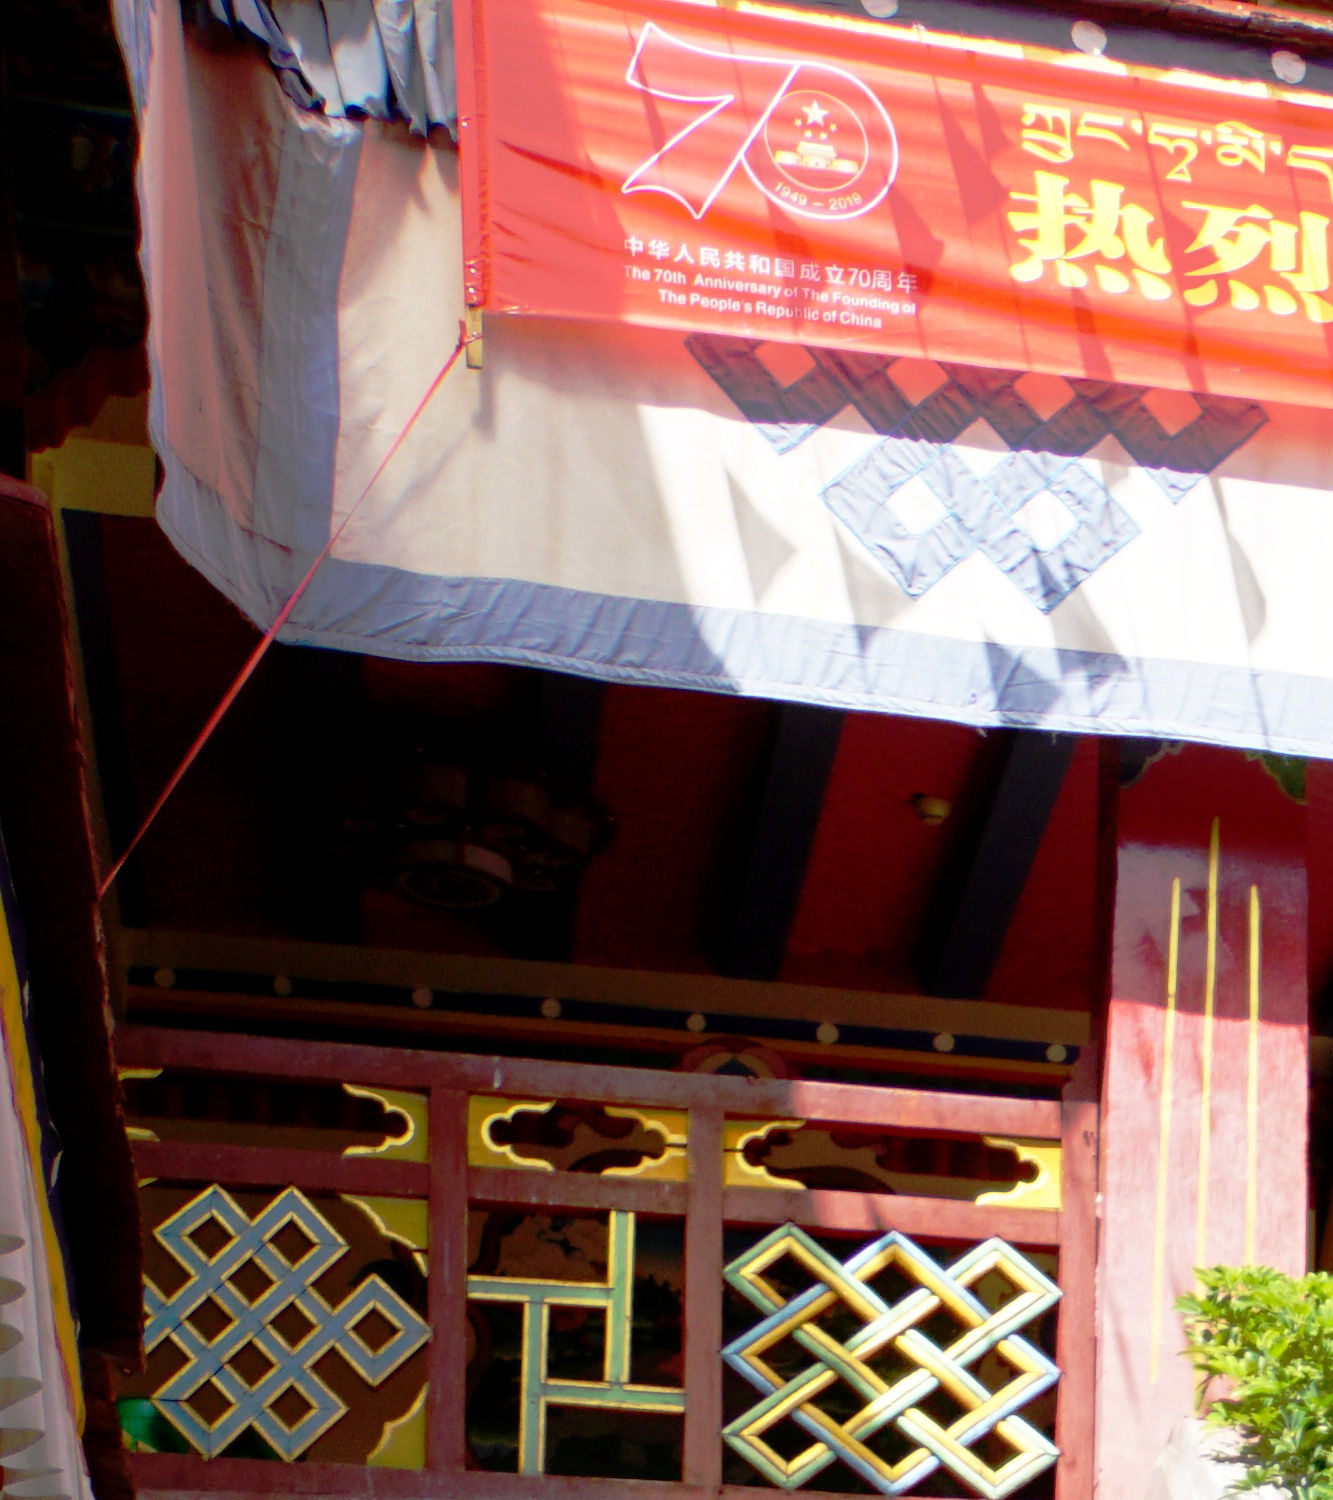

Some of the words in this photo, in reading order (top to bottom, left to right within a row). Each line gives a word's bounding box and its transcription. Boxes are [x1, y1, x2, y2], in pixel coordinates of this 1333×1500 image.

[774, 181, 808, 206] 1949
[829, 192, 863, 211] 2019
[624, 236, 920, 294] 中华人民共和国成立70周年
[624, 265, 651, 281] The
[654, 269, 687, 286] 70th
[694, 272, 782, 300] Anniversary
[803, 287, 831, 303] The
[832, 291, 899, 314] Founding
[658, 288, 688, 306] The
[690, 293, 754, 314] People's
[755, 302, 820, 322] Republic
[822, 310, 838, 325] of
[840, 312, 883, 328] China
